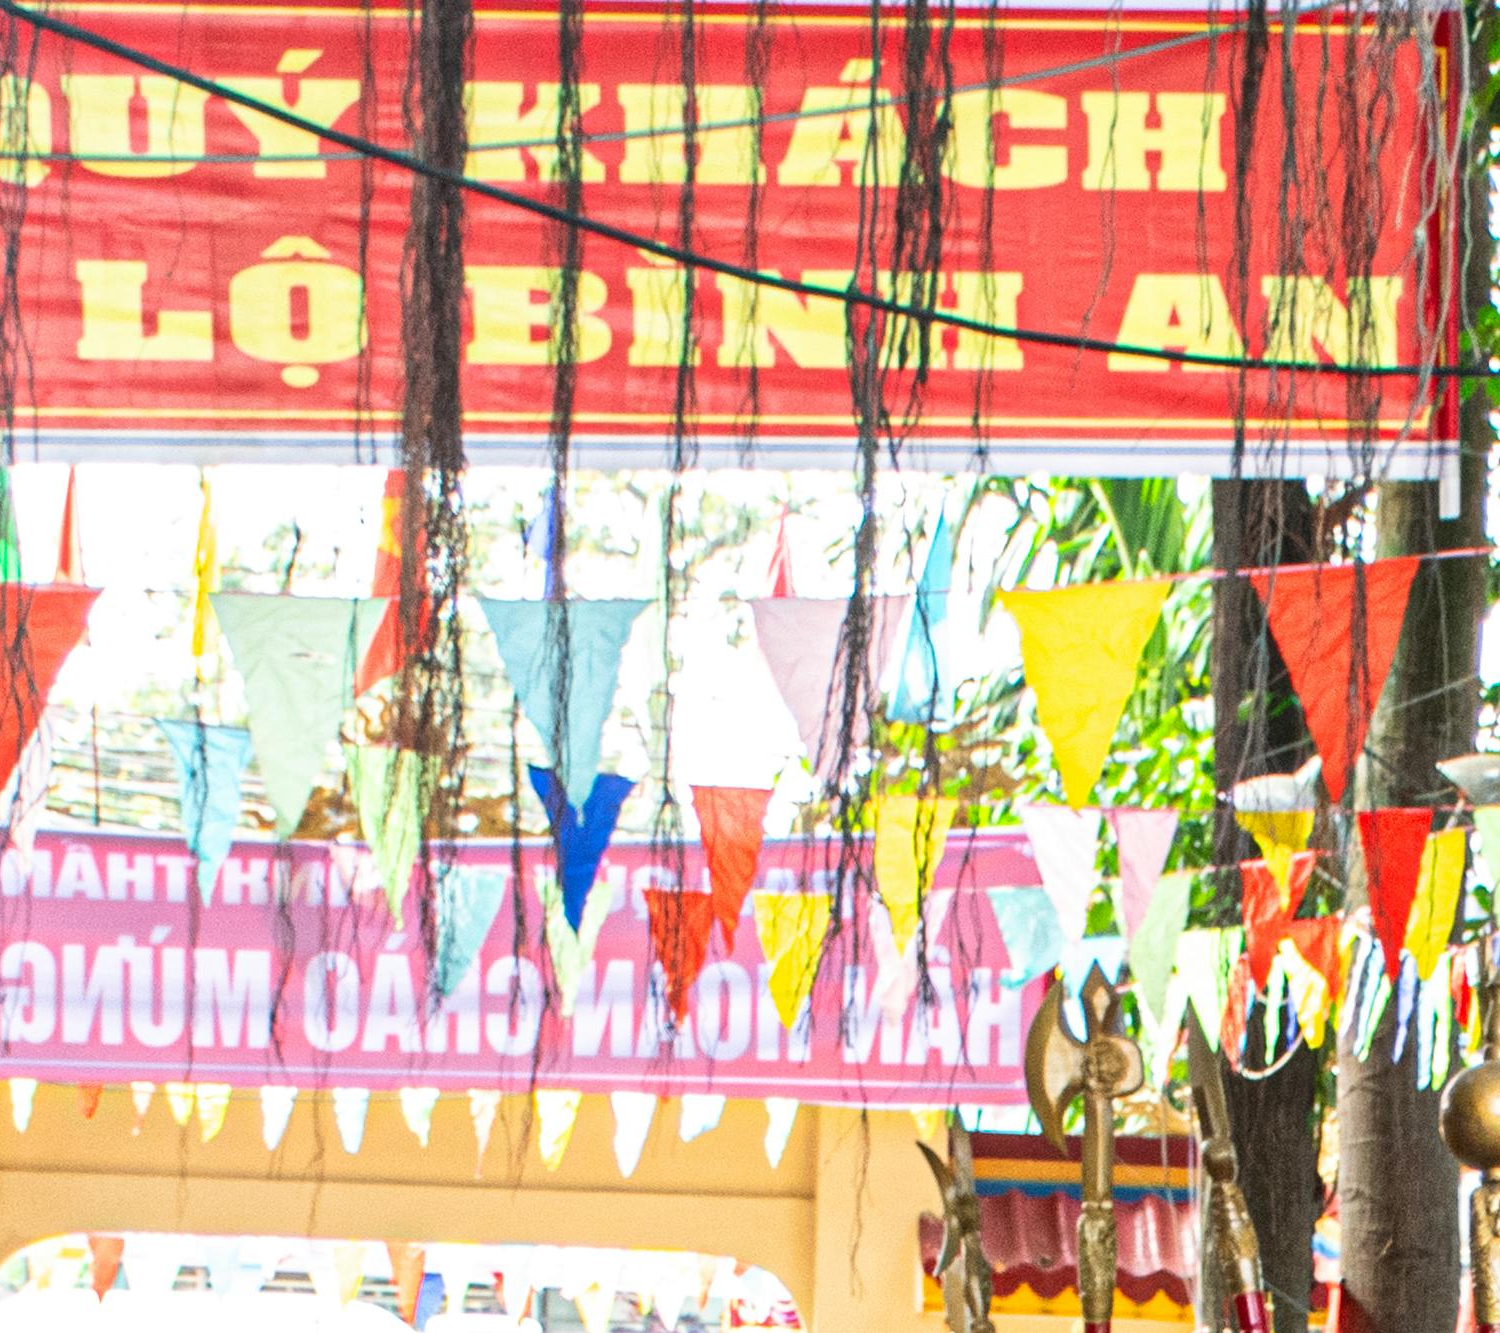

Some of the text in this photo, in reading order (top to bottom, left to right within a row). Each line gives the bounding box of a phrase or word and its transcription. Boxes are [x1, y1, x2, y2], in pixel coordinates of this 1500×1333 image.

[464, 58, 1228, 191] KHÁCH
[76, 235, 368, 389] LỘ
[465, 241, 1025, 371] BÌNH
[1107, 272, 1401, 372] AN
